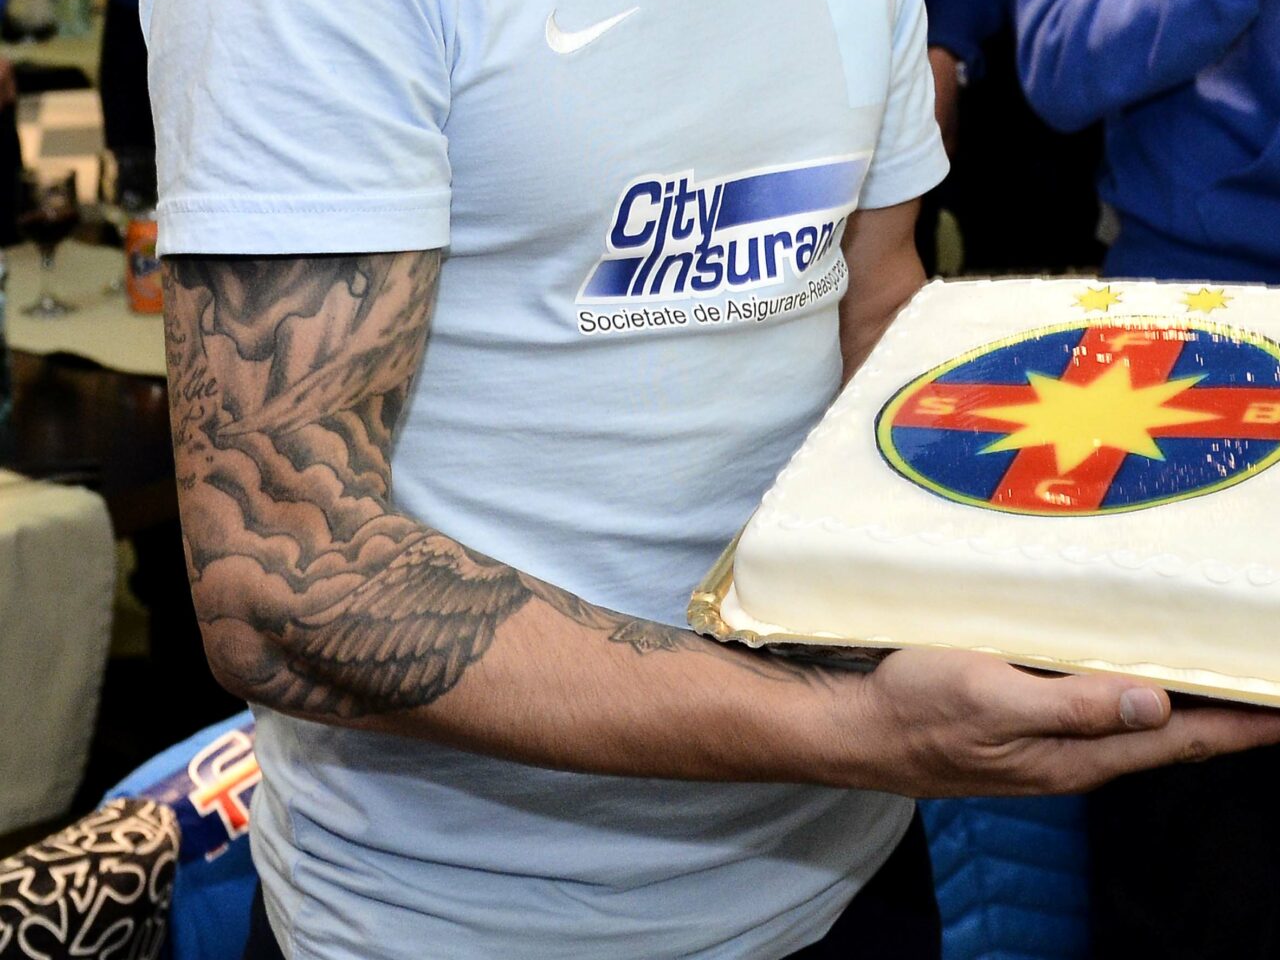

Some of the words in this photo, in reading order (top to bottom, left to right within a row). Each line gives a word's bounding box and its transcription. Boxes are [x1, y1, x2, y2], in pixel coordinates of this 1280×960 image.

[610, 177, 722, 251] City
[578, 306, 688, 333] Societate
[693, 304, 720, 323] de
